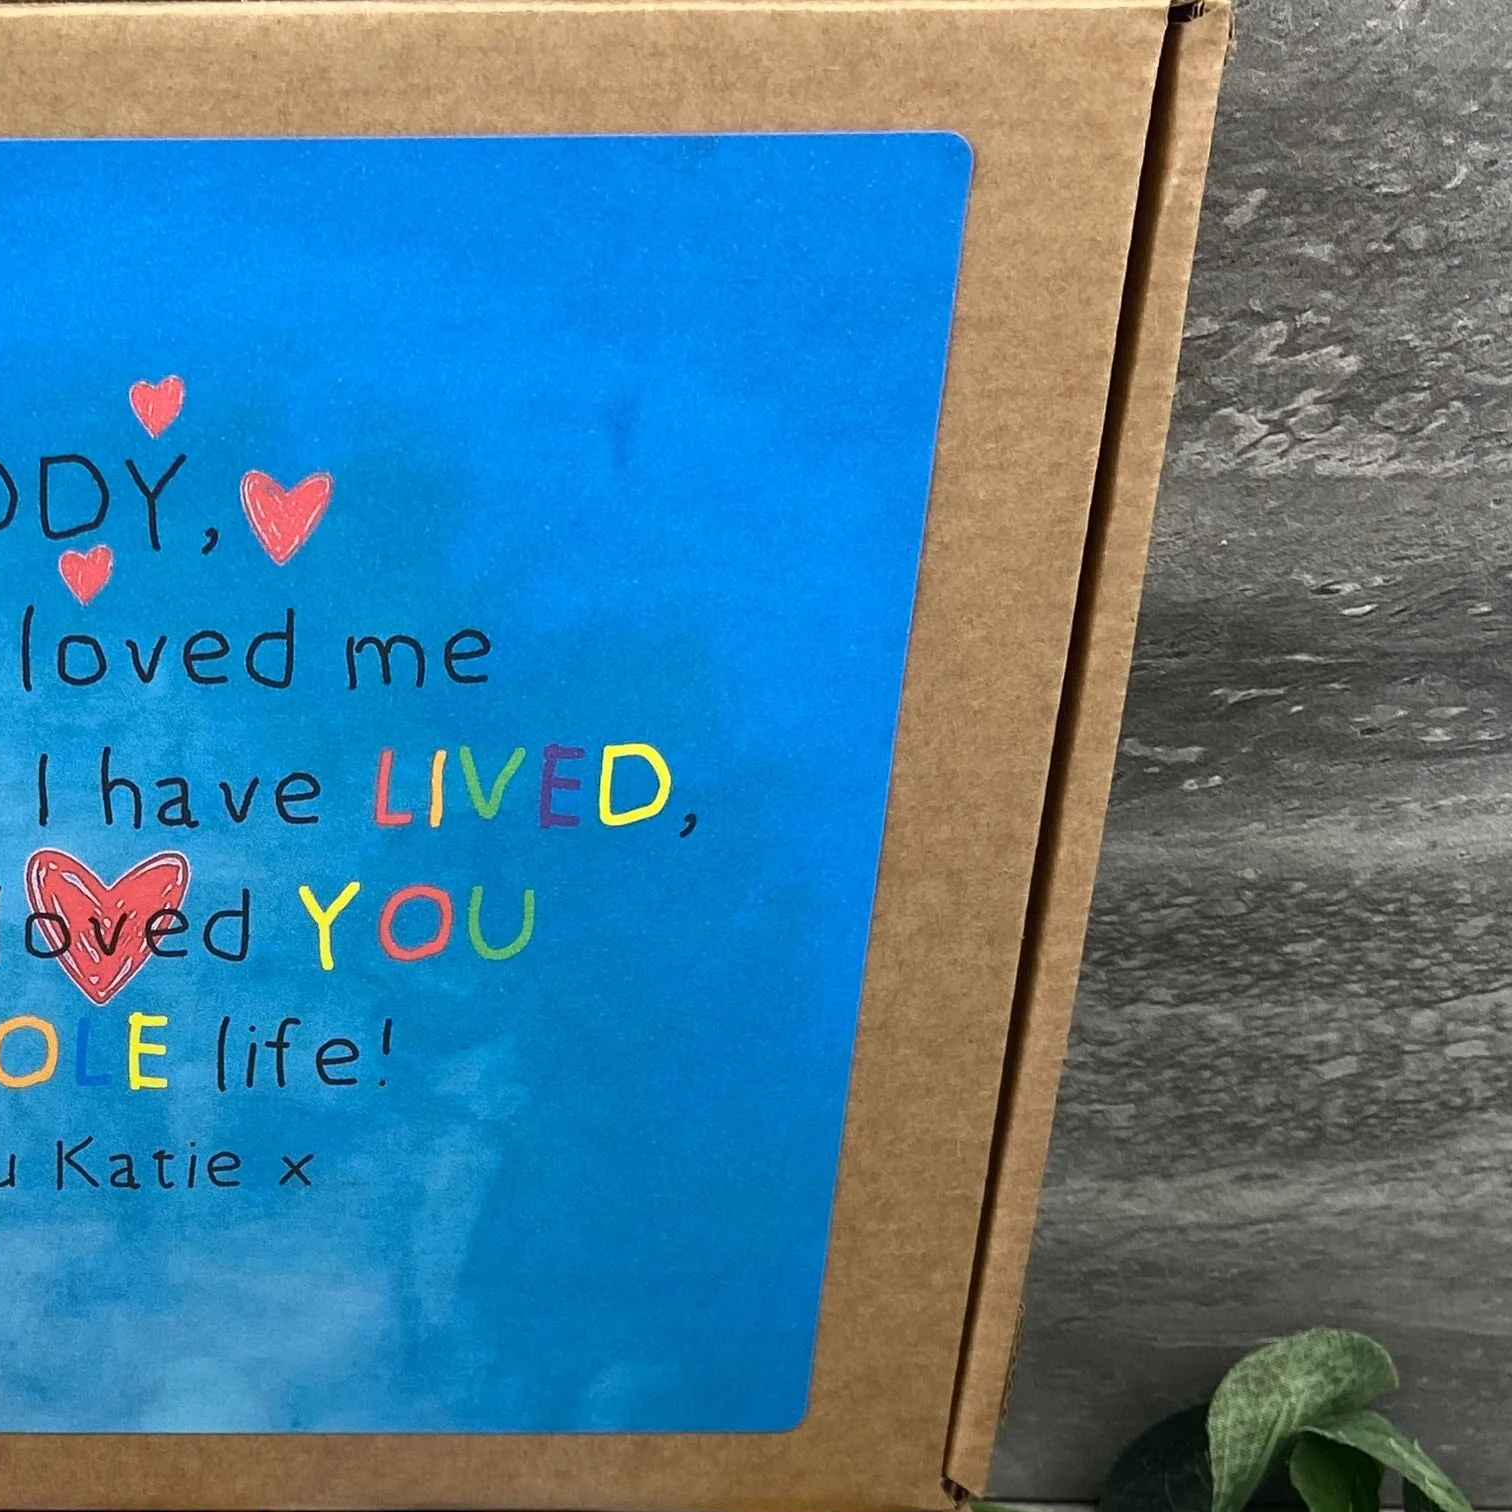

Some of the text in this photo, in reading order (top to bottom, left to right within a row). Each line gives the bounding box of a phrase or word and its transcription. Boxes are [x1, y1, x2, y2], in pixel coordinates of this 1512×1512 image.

[21, 605, 294, 692] loved
[346, 628, 491, 690] me
[37, 753, 49, 827] I
[100, 746, 321, 829] have
[374, 743, 698, 838] LIVED,
[298, 881, 535, 972] YOU
[216, 1015, 393, 1092] life!
[56, 1135, 242, 1191] Katie
[279, 1153, 314, 1186] x
